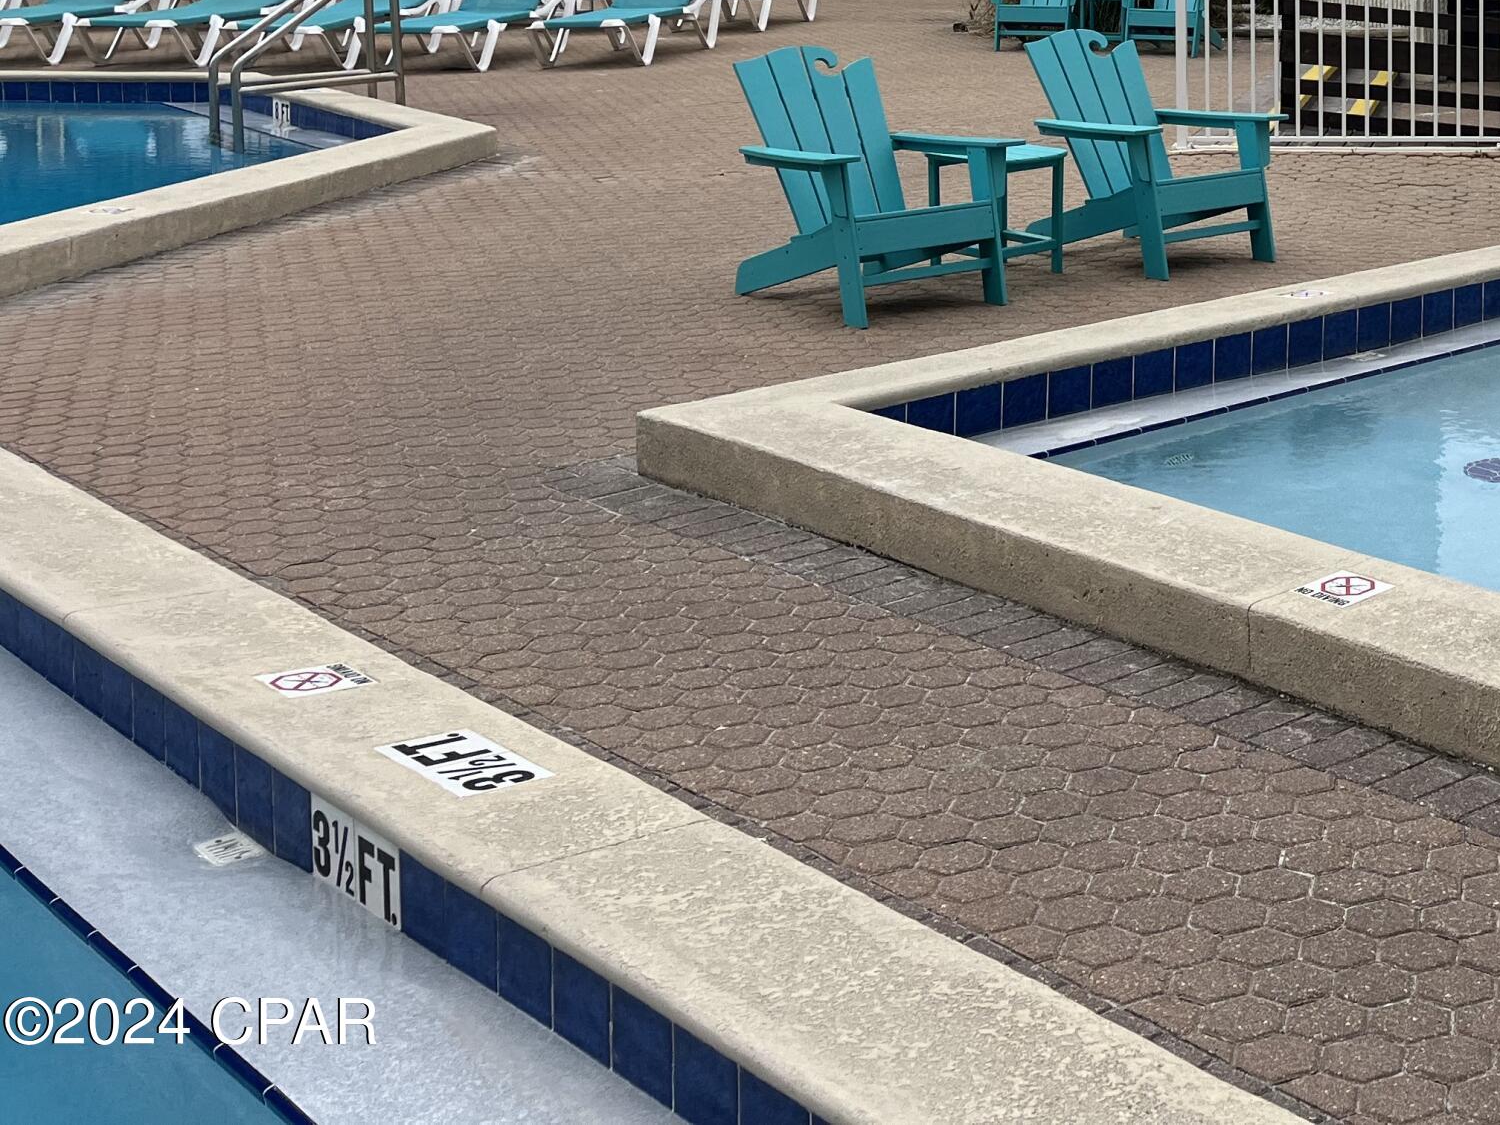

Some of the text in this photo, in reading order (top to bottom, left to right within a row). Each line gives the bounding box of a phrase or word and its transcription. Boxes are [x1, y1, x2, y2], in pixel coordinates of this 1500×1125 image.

[1311, 592, 1350, 606] DIVING
[326, 664, 373, 685] NO DIVING
[391, 732, 490, 767] FT.
[357, 834, 398, 927] FT.
